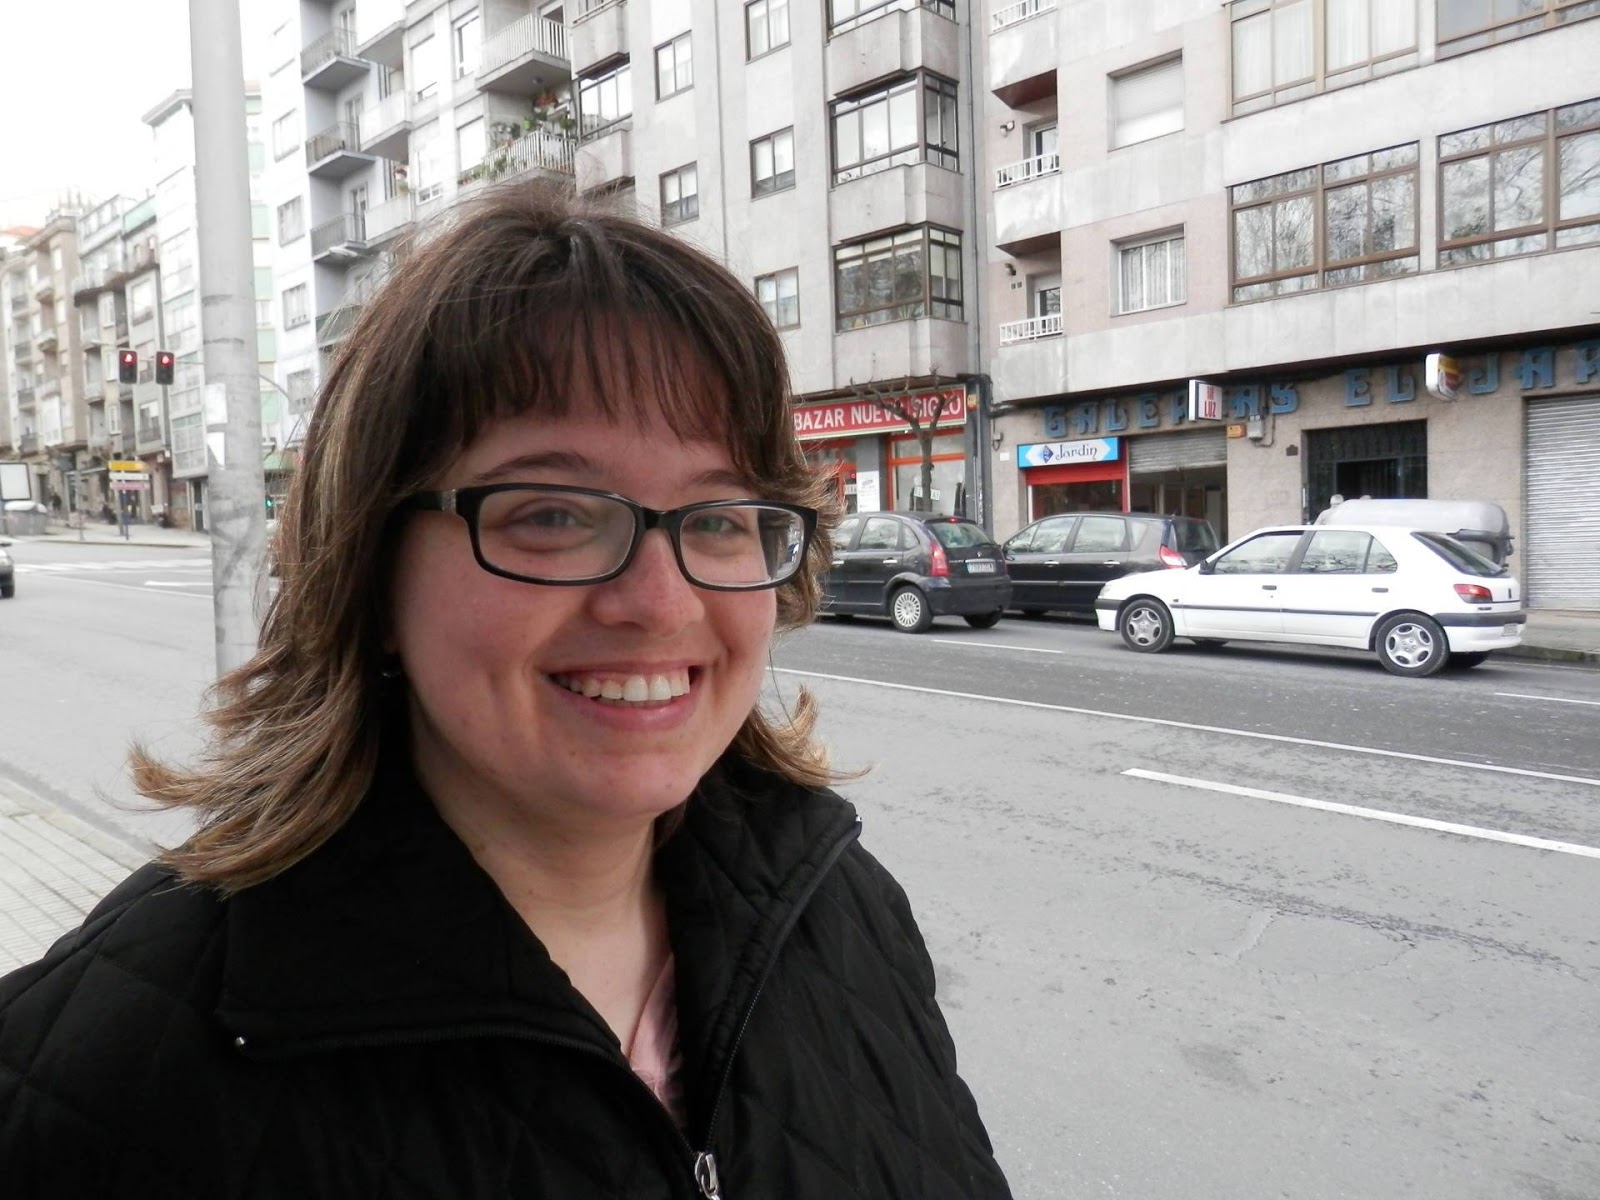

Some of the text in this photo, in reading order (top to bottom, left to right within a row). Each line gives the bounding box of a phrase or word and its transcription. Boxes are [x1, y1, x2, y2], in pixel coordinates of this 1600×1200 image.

[1041, 381, 1299, 438] GALERAS
[1343, 362, 1416, 407] EL
[793, 406, 845, 431] BAZAR
[1055, 443, 1098, 461] Jardin
